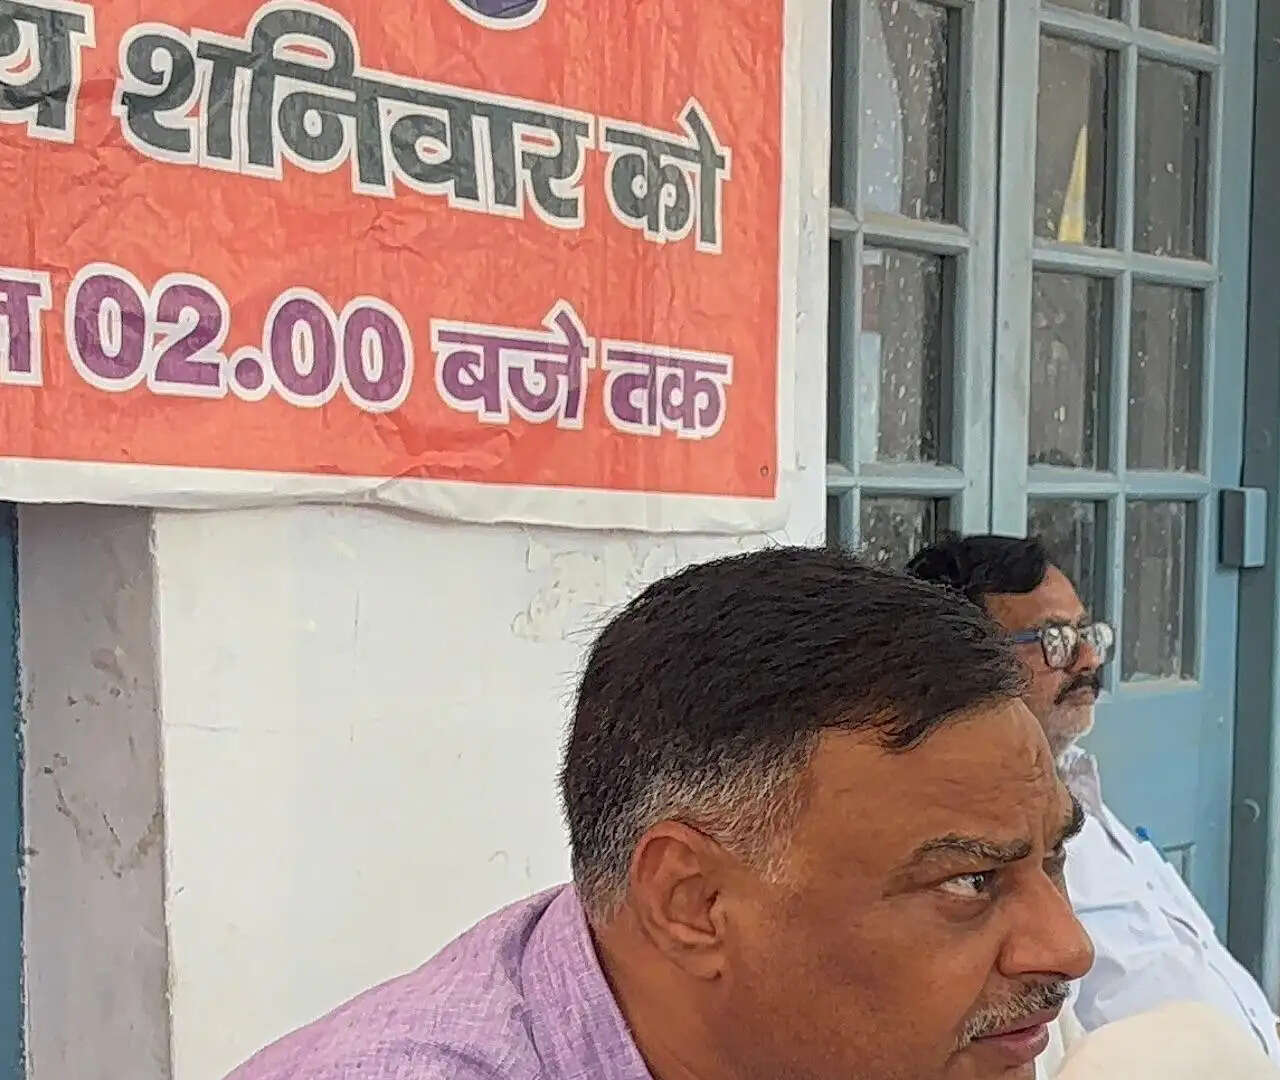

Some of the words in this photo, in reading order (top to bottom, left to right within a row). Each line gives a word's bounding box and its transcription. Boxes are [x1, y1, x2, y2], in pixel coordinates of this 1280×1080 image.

[120, 8, 592, 221] शनिवार
[604, 106, 727, 247] को
[73, 274, 406, 402] 02.00
[437, 312, 590, 424] बजे
[606, 348, 728, 432] तक
